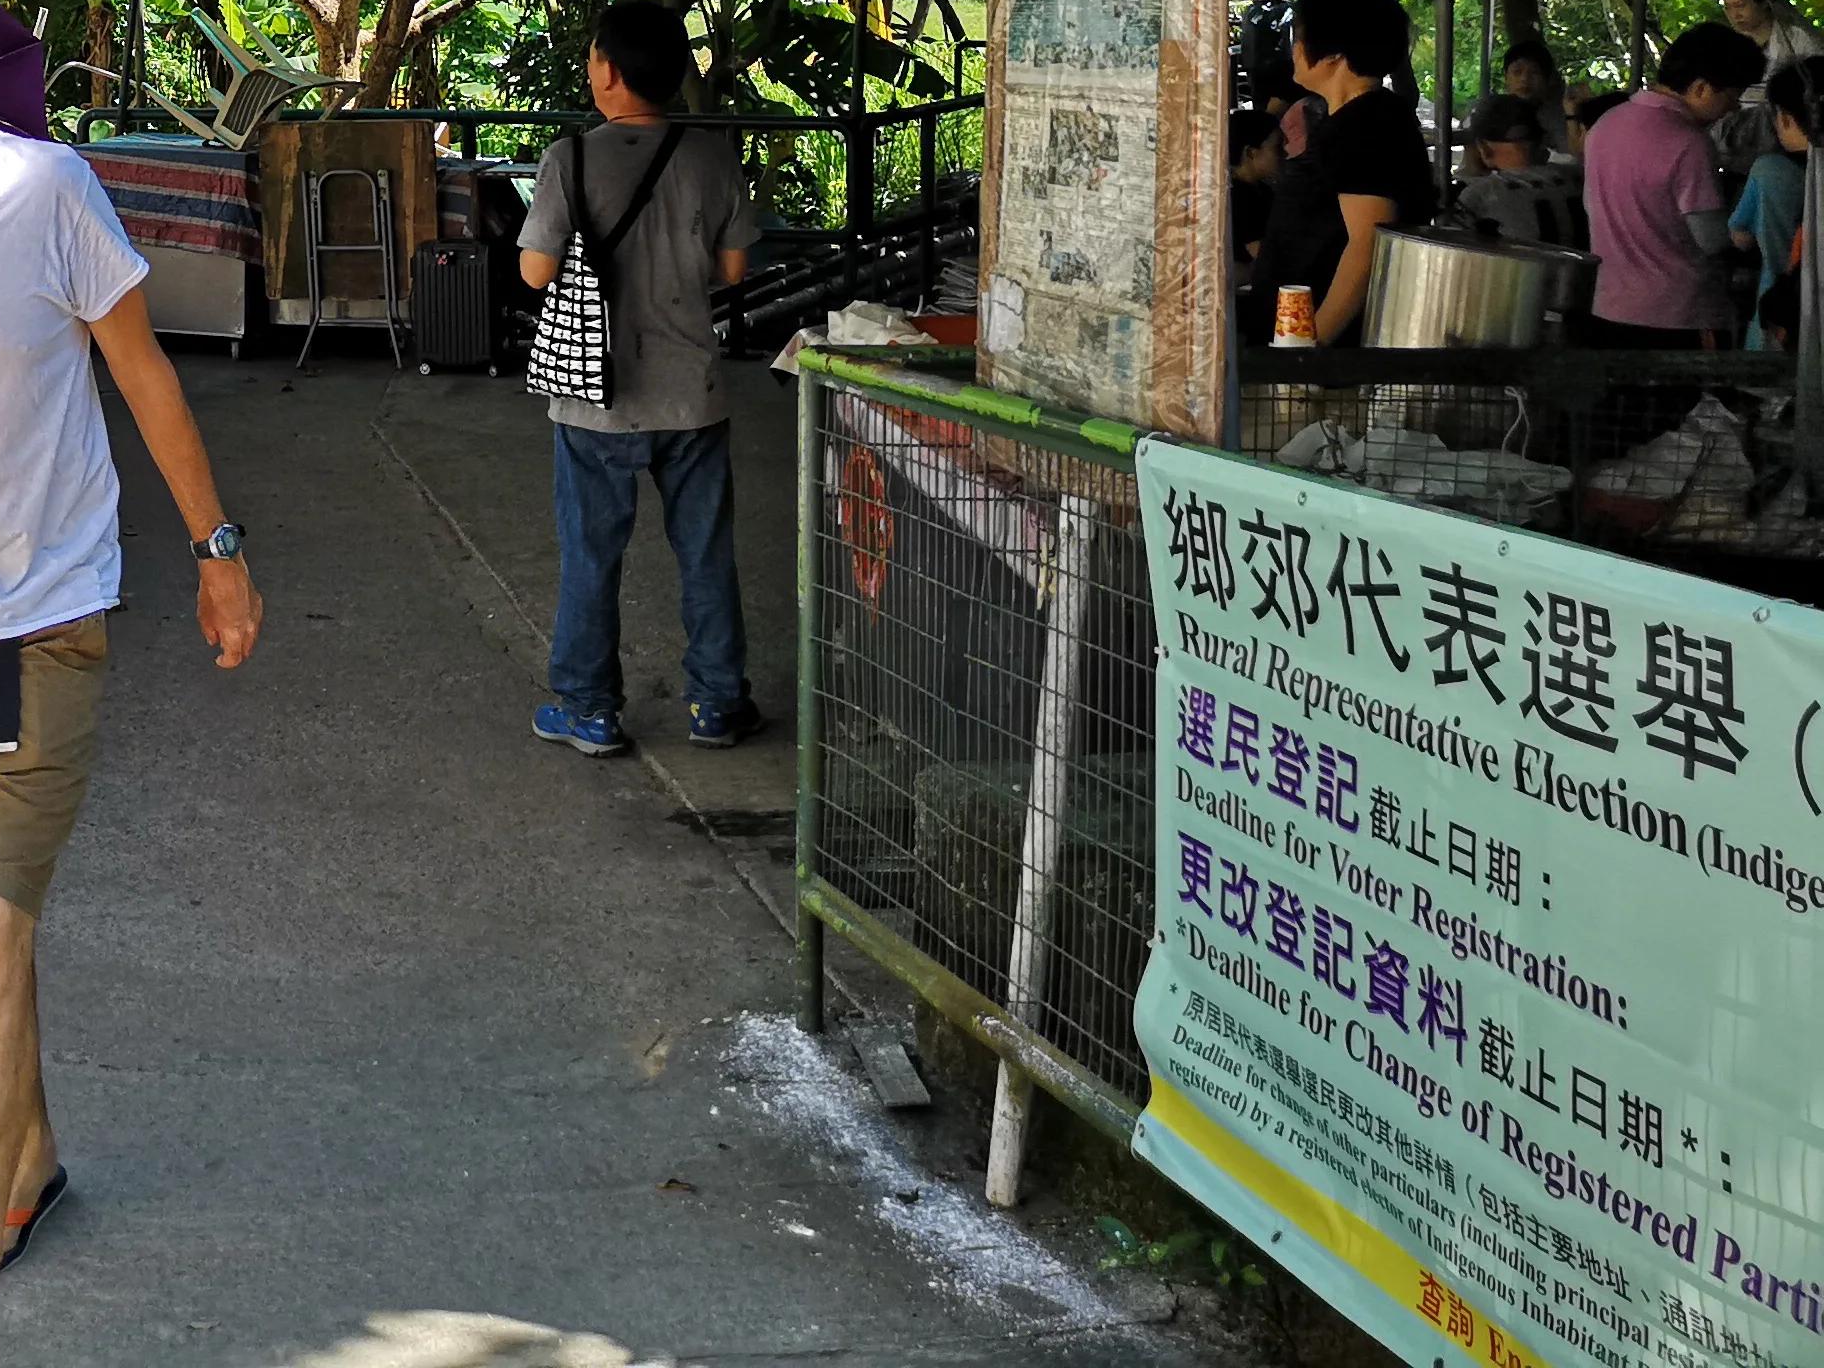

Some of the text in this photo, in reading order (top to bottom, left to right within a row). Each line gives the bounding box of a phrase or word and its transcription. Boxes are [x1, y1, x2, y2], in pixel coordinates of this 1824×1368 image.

[1175, 609, 1258, 682] Rural
[1263, 642, 1500, 782] Representative
[1513, 738, 1689, 858] Election
[1176, 765, 1627, 1030] Deadline for Voter Registration:
[1168, 1056, 1248, 1118] registered)
[1250, 1099, 1273, 1132] by
[1274, 1119, 1285, 1138] a
[1287, 1126, 1359, 1189] registered
[1360, 1178, 1405, 1224] elector
[1407, 1216, 1425, 1240] of
[1425, 1223, 1517, 1307] Indigenous
[1172, 1024, 1242, 1078] Deadline
[1245, 1063, 1267, 1093] for
[1270, 1083, 1315, 1128] change
[1316, 1117, 1330, 1139] of
[1331, 1129, 1368, 1166] other
[1370, 1157, 1457, 1228] particulars
[1460, 1213, 1547, 1296] (including
[1552, 1278, 1651, 1350] principal
[1299, 989, 1338, 1043] for
[1344, 1019, 1452, 1119] Change
[1461, 1098, 1494, 1145] of
[1500, 1109, 1697, 1265] Registered
[1708, 1228, 1824, 1336] Parti
[1416, 1269, 1475, 1348] 查詢
